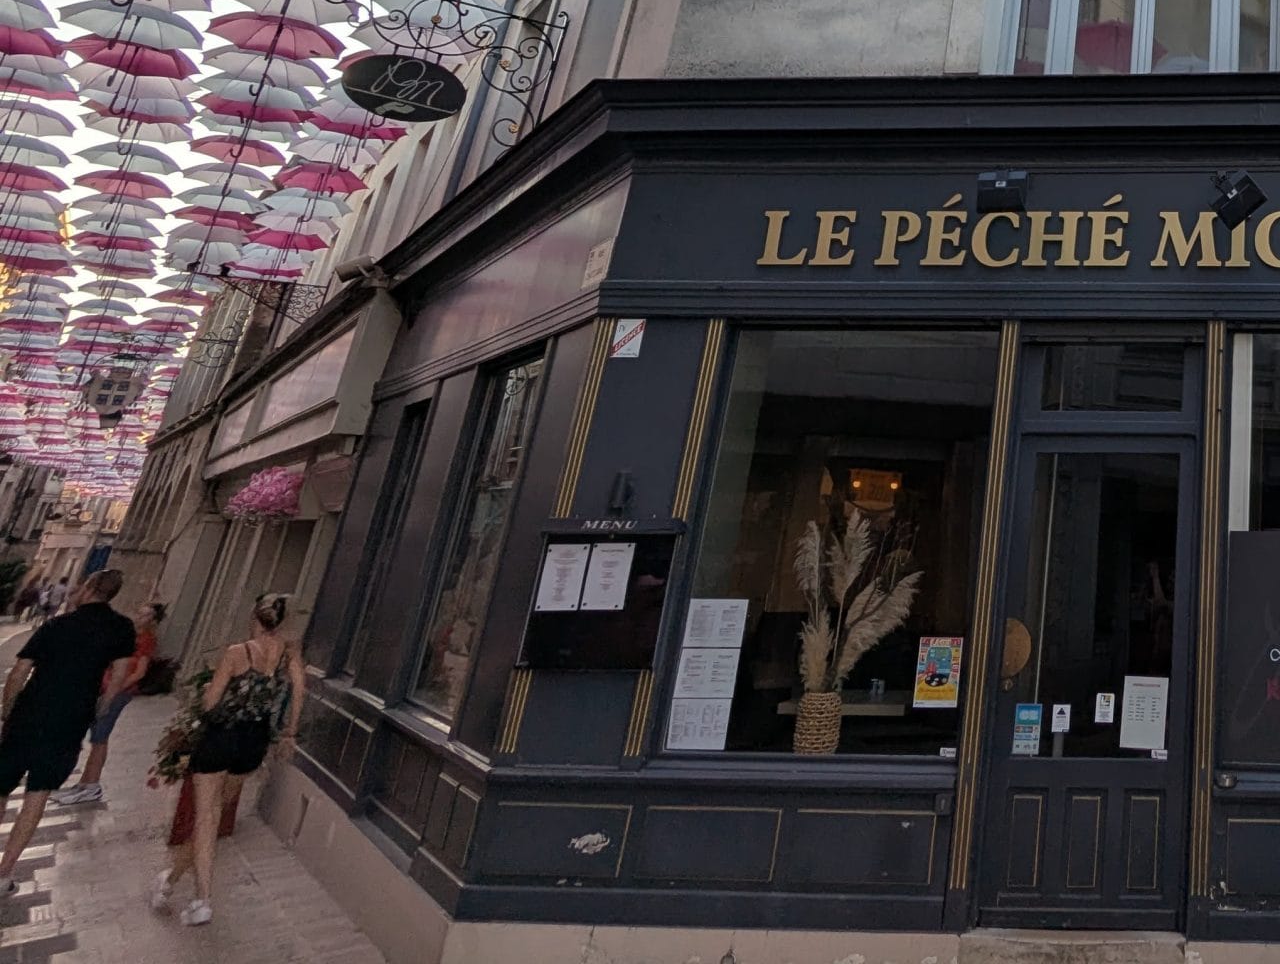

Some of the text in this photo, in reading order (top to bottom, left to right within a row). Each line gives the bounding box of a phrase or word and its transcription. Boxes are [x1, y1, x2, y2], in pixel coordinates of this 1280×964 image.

[756, 209, 857, 267] LE
[873, 193, 1131, 268] PÉCHÉ
[580, 520, 638, 531] MENU
